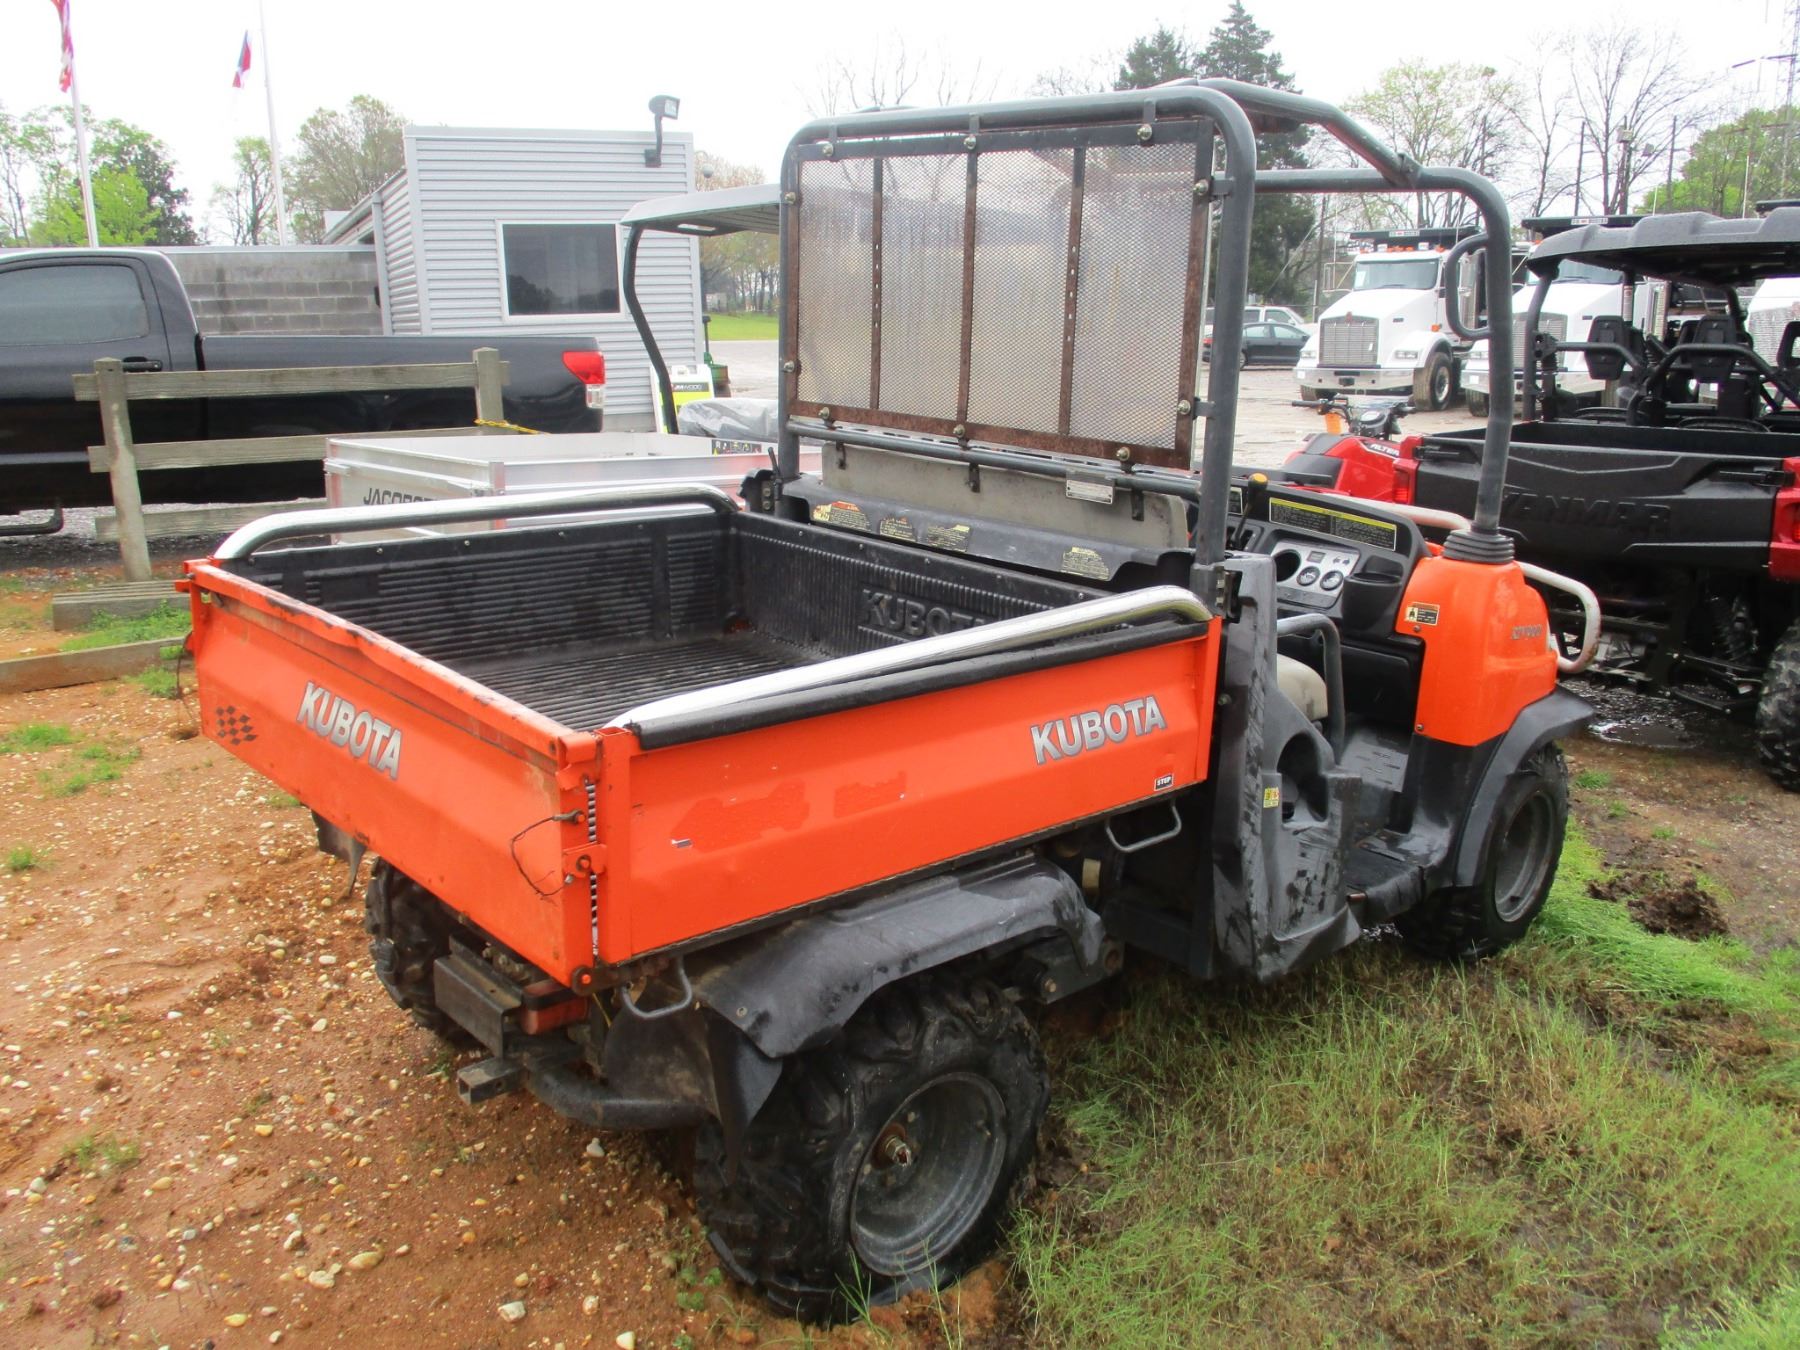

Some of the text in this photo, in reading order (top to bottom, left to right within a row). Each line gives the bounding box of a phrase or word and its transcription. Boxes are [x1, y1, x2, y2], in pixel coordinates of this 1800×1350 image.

[363, 487, 437, 505] JACOB
[862, 588, 985, 637] KUBOT
[296, 680, 402, 781] KUBOTA
[1030, 695, 1167, 766] KUBOTA
